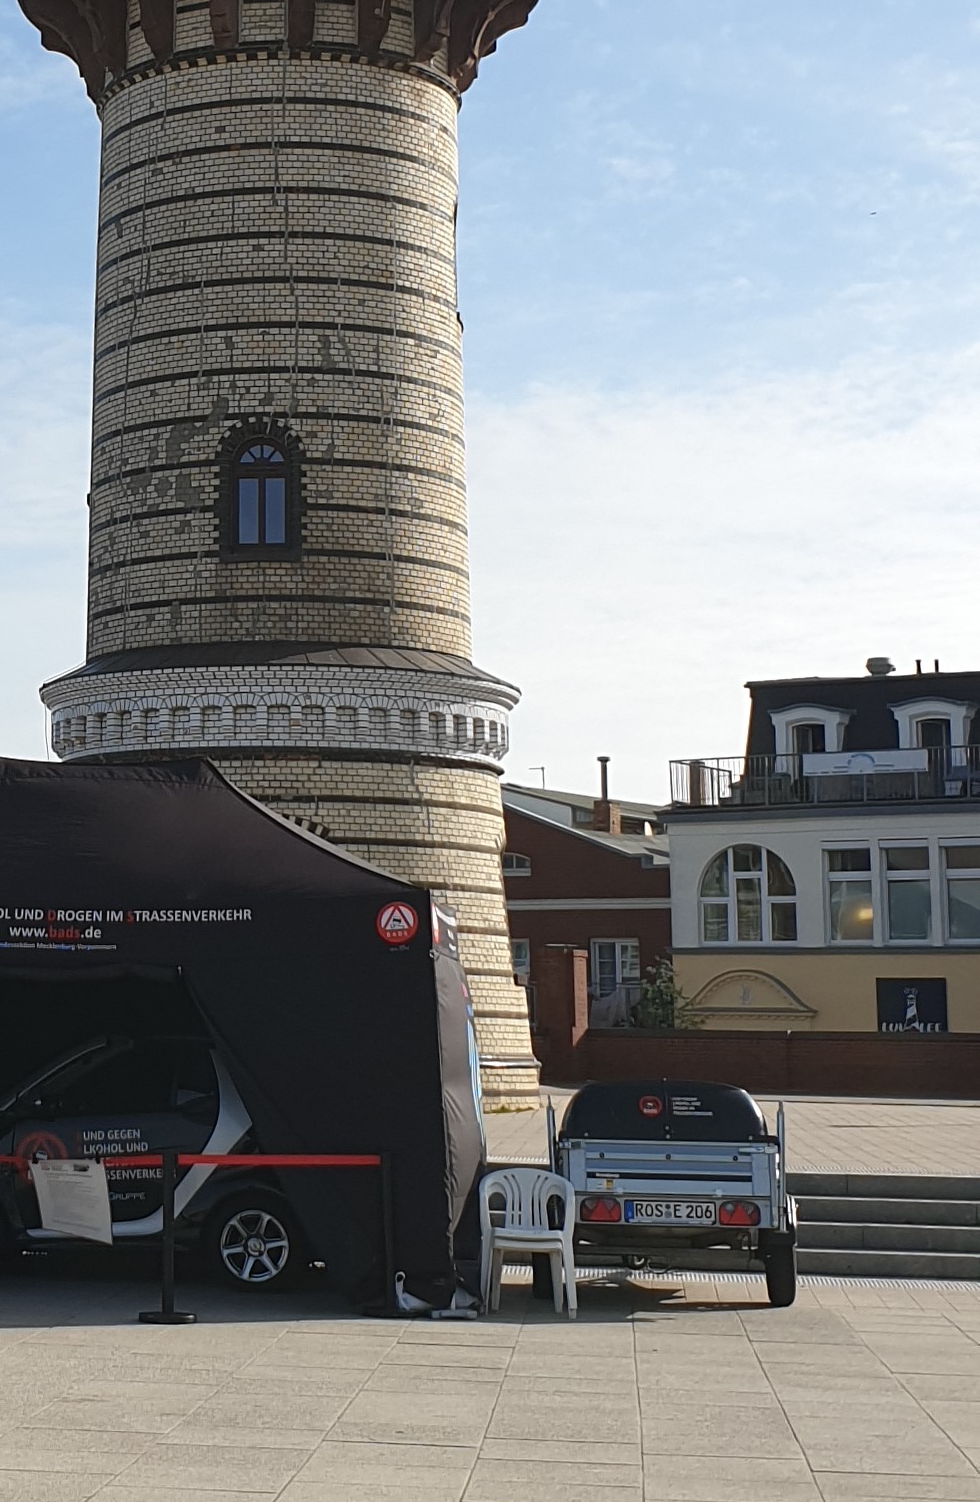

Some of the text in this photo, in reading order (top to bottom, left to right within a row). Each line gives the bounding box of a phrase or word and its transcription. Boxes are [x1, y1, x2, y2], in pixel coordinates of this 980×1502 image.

[14, 907, 44, 921] UND
[47, 908, 103, 923] DROGEN
[106, 909, 124, 923] IM
[126, 908, 253, 923] STRASSENVERKEHR
[9, 925, 102, 939] www.bads.de
[107, 1128, 141, 1141] GEGEN
[126, 1141, 149, 1153] UND
[634, 1202, 714, 1220] ROS E 206
